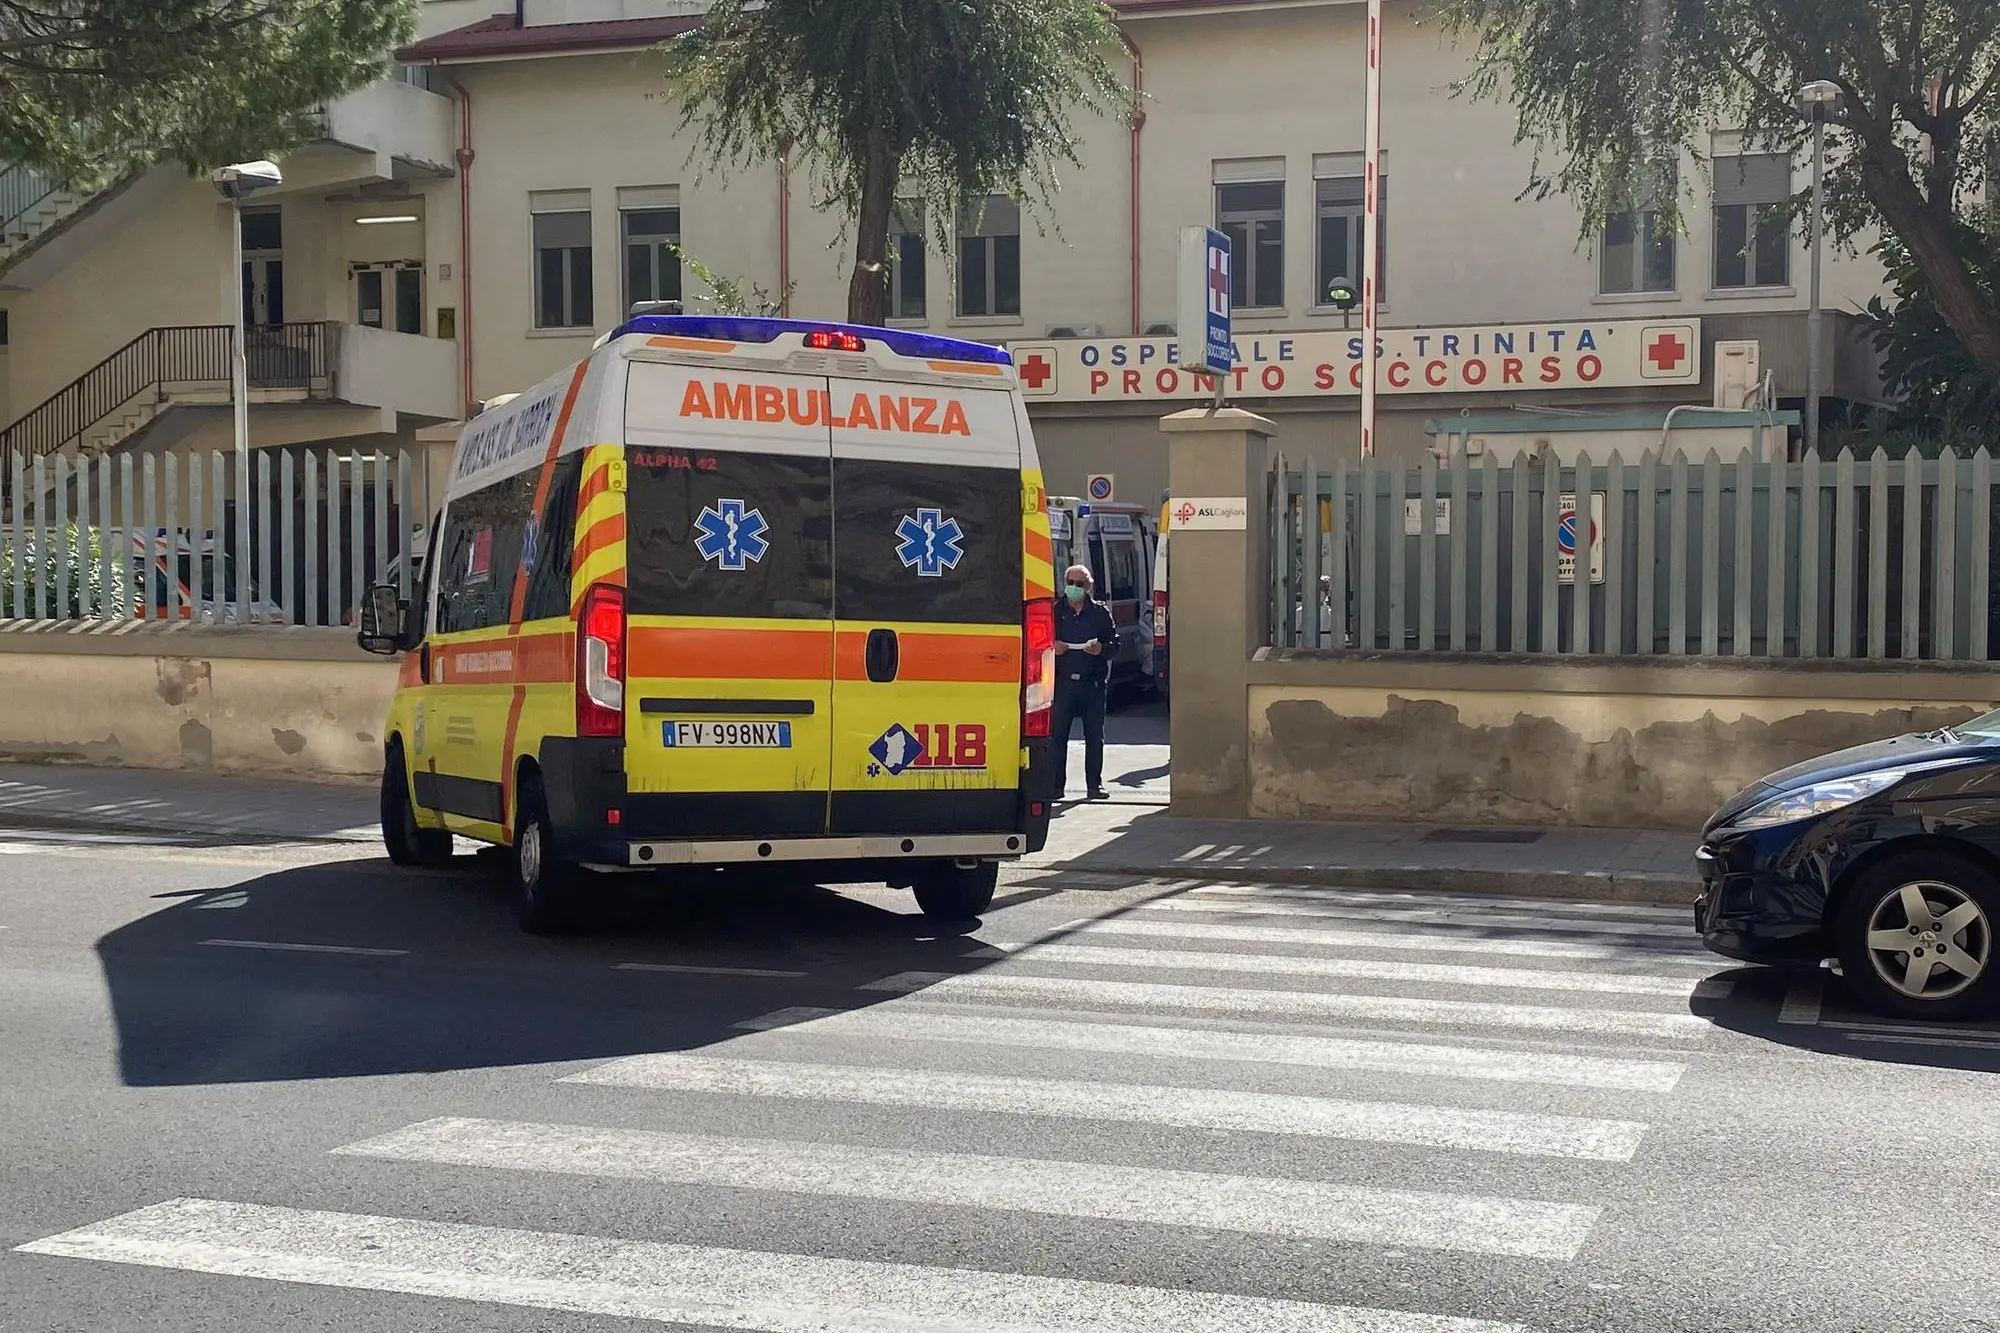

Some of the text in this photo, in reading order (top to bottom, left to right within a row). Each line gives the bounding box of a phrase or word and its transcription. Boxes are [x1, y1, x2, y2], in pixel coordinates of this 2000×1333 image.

[1080, 339, 1295, 367] OSPEALE
[1090, 365, 1286, 395] PRONTO
[679, 380, 971, 436] AMBULANZA
[634, 452, 692, 469] ALPHA
[713, 724, 777, 745] 998NX
[913, 724, 986, 766] 118
